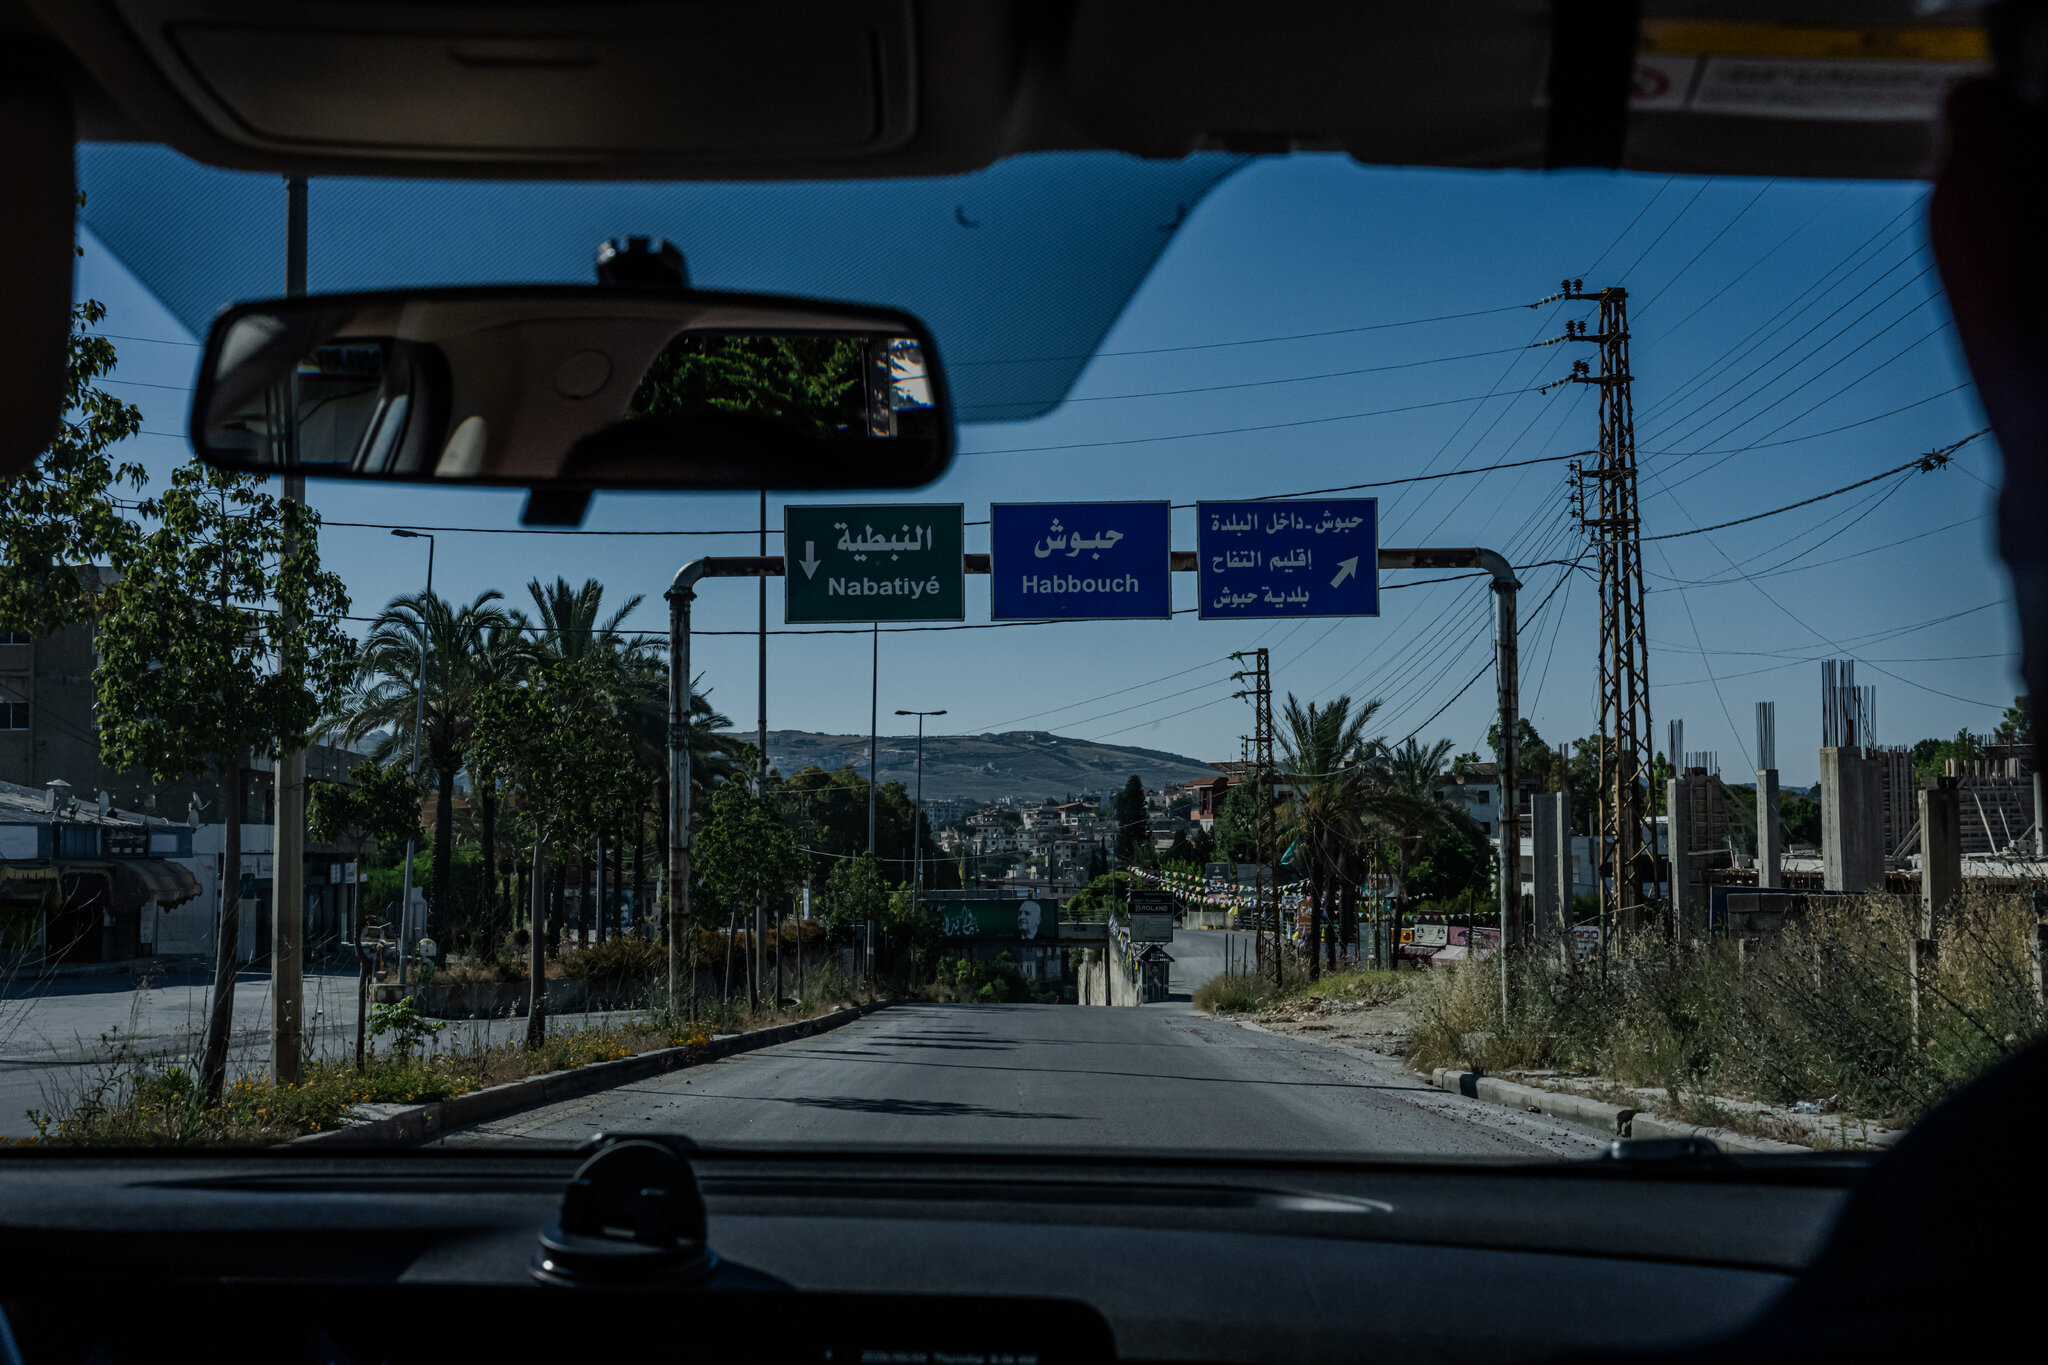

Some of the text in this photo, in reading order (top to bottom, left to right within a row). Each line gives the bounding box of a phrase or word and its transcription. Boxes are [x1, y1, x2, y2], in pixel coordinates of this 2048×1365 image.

[1211, 513, 1259, 537] البلدة
[833, 521, 933, 562] النبطية
[1033, 517, 1125, 561] حبوش
[1212, 548, 1312, 573] إقليم التفاح
[828, 575, 940, 599] Nabatiyé
[1022, 573, 1139, 594] Habbouch
[1213, 585, 1310, 609] بلدية حبوش
